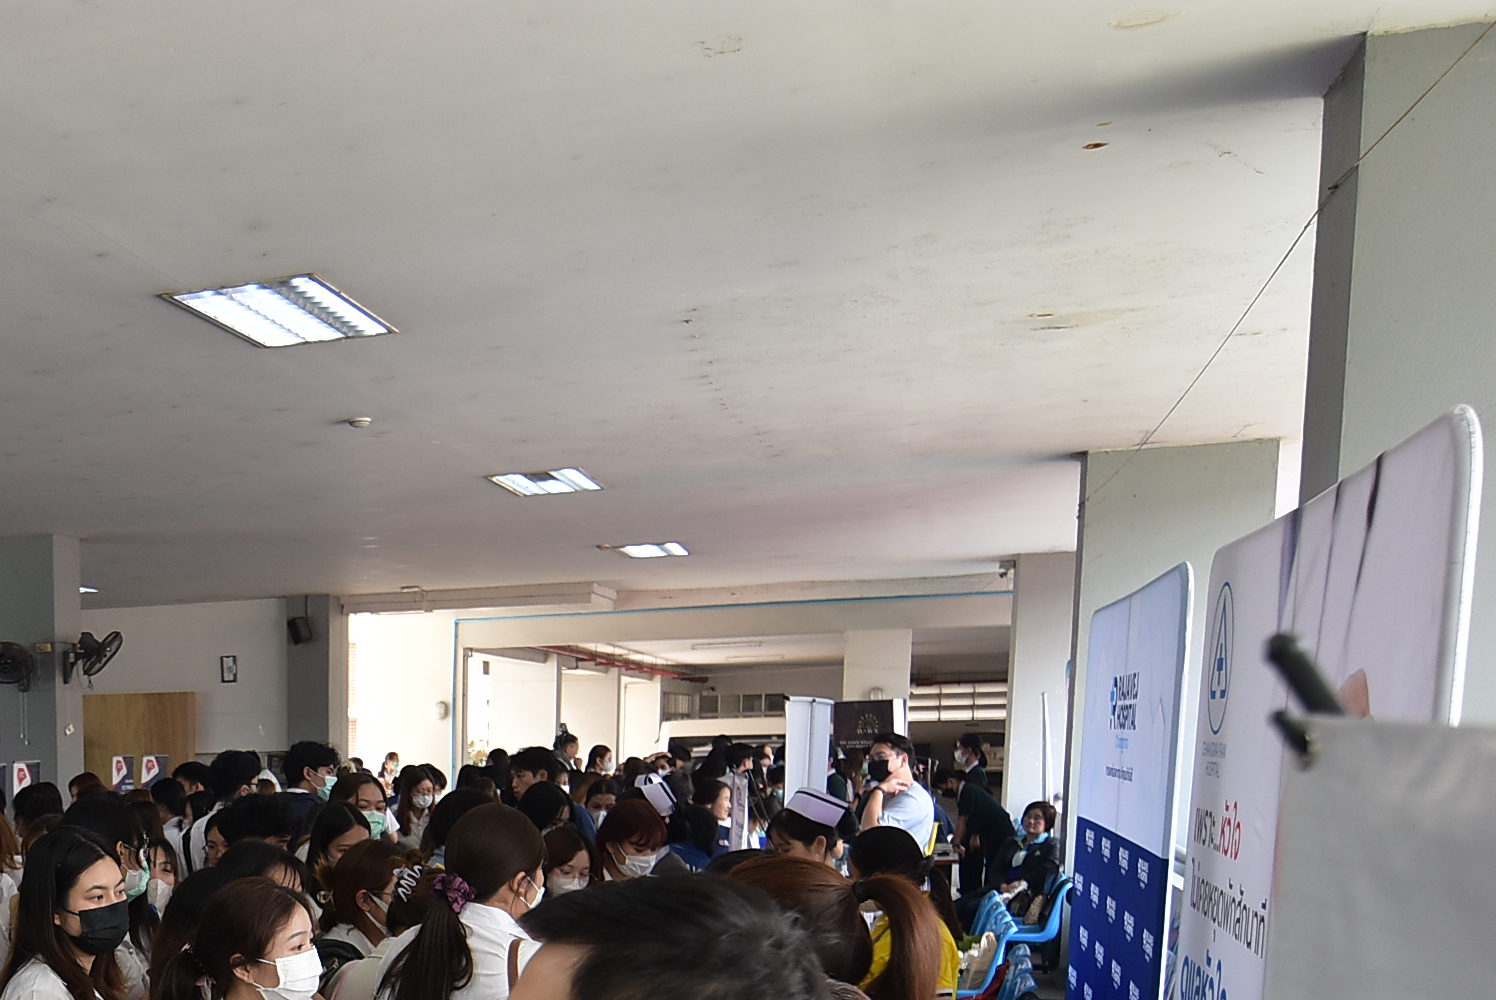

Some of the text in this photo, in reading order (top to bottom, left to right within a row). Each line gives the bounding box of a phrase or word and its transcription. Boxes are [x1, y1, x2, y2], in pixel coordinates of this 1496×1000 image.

[1190, 857, 1268, 959] ไม่เคยหยุดพักสักนาที
